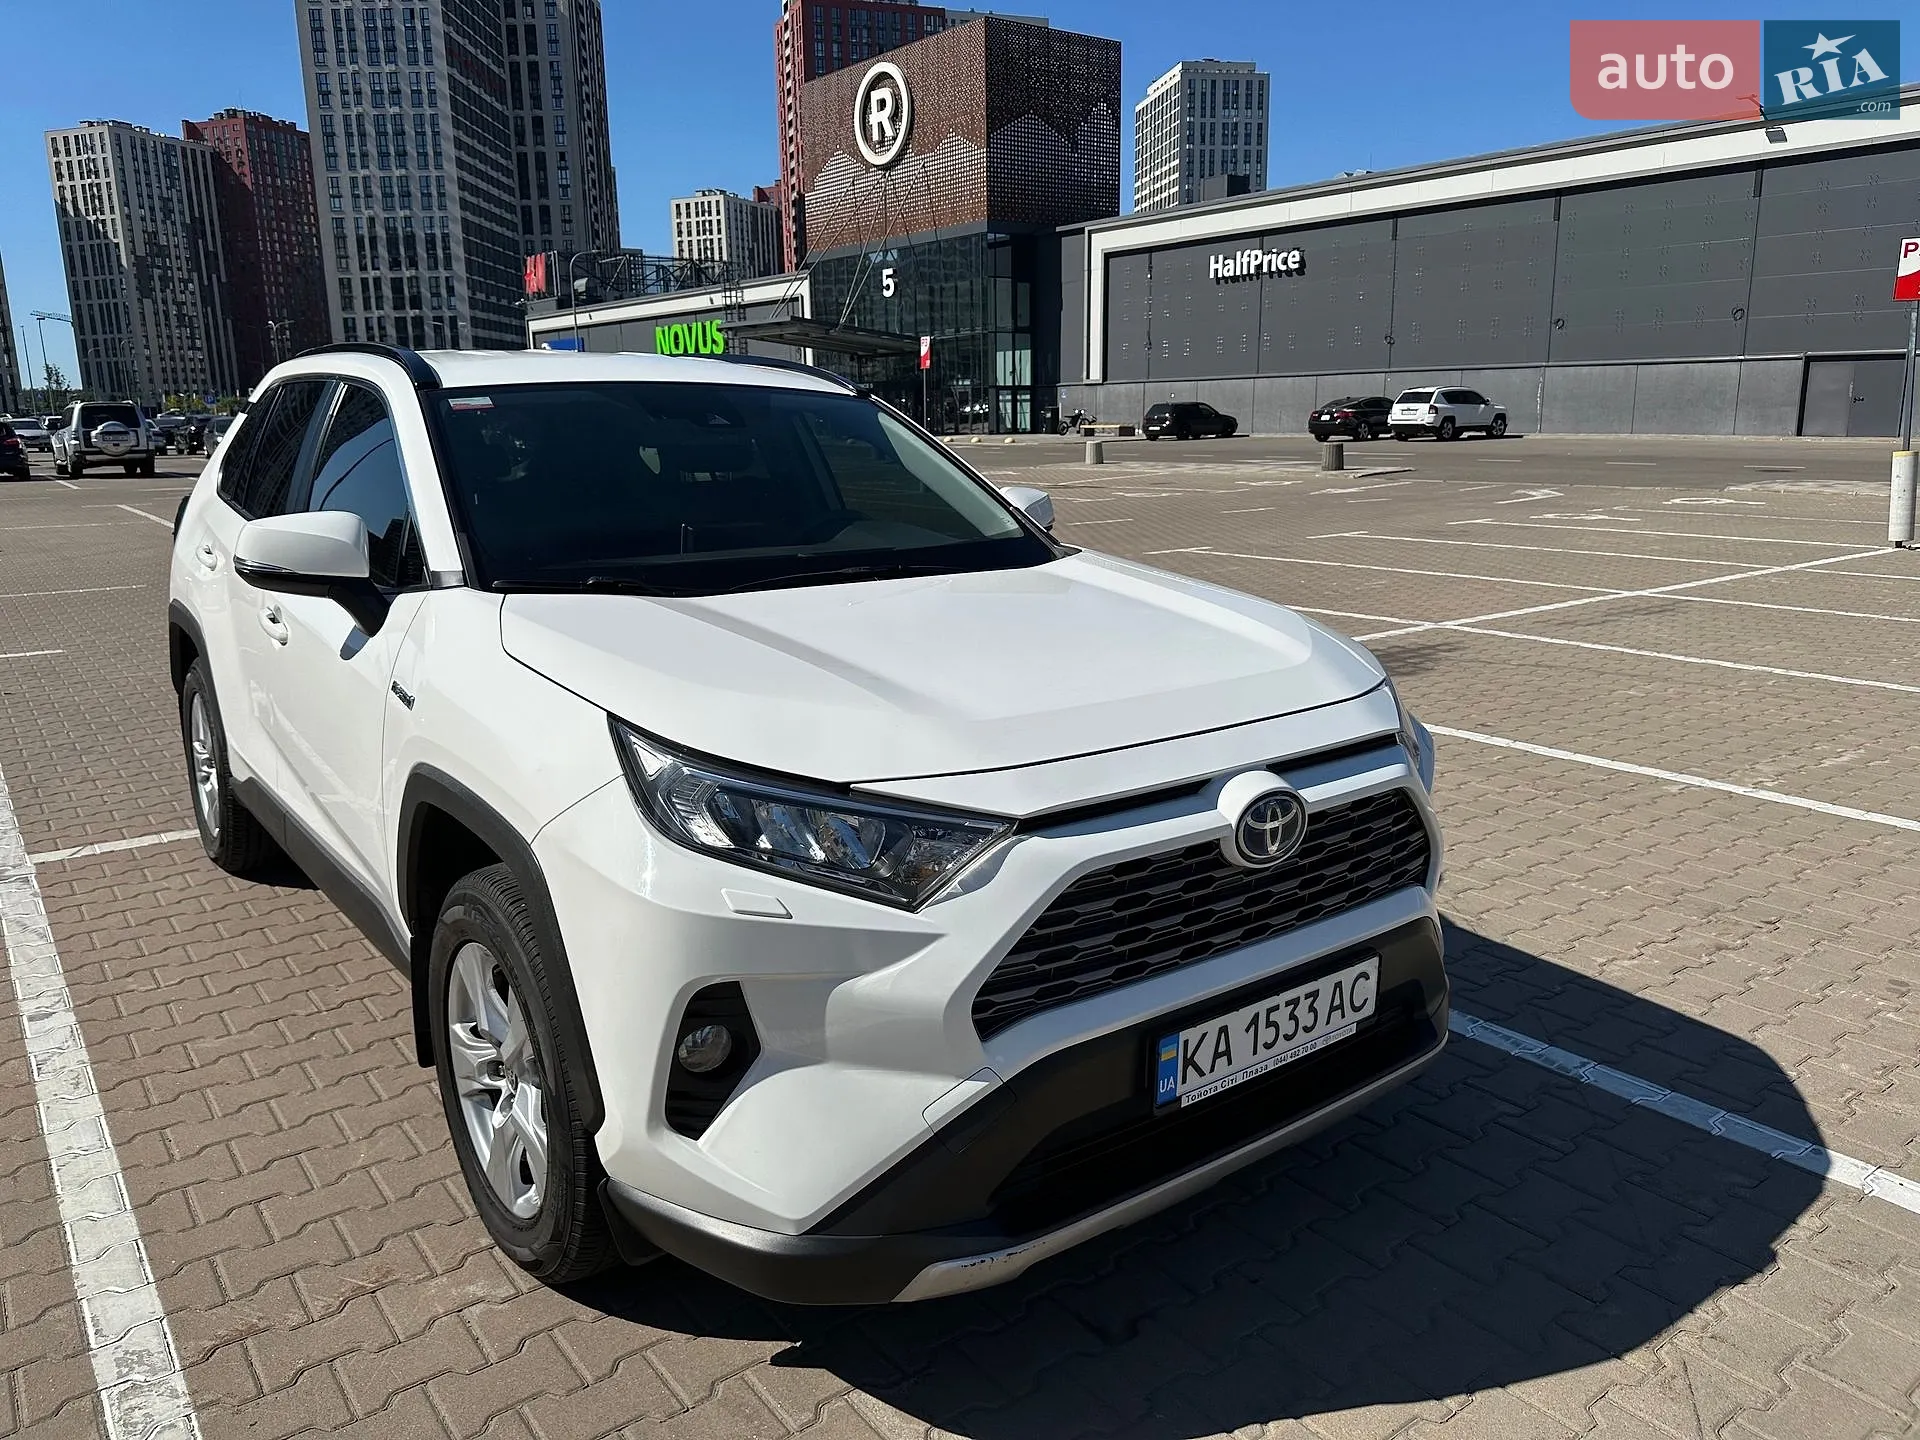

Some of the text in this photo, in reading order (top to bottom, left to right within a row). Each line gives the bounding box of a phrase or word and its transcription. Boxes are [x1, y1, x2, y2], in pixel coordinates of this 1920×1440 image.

[1209, 248, 1301, 279] HalfPrice
[1903, 242, 1920, 258] P
[882, 268, 895, 298] 5
[655, 319, 724, 355] NOVUS
[1181, 971, 1370, 1085] KA 1533 AC
[1159, 1076, 1175, 1093] UA
[1242, 1064, 1268, 1080] Плаза
